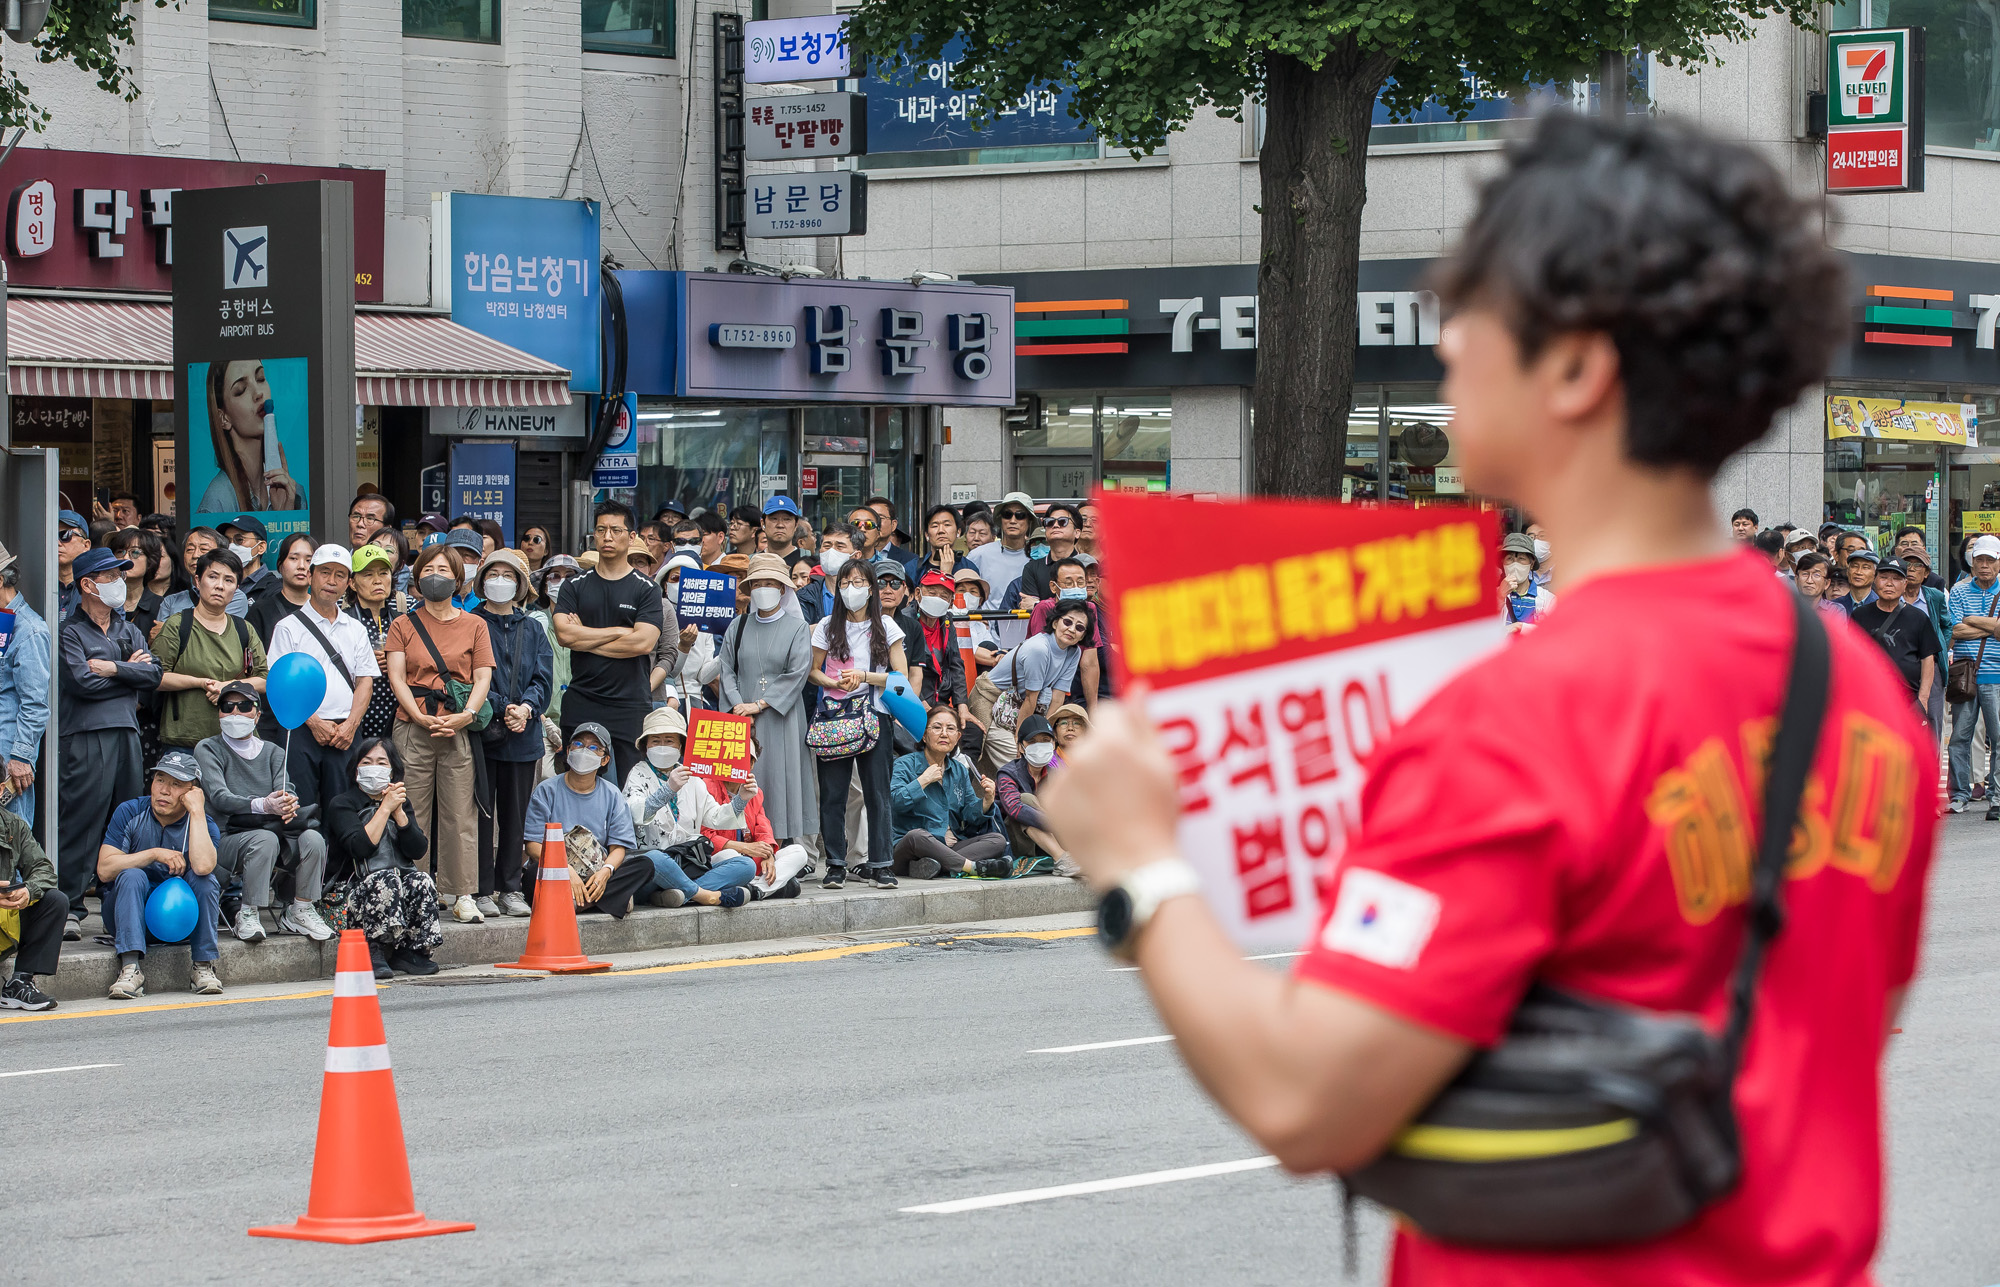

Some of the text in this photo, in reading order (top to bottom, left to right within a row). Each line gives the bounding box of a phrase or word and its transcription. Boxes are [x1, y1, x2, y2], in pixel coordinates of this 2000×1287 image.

[778, 31, 844, 65] 보청기
[751, 105, 775, 126] 북촌
[780, 103, 826, 118] T.755-1452
[775, 118, 844, 149] 단팥빵
[1832, 149, 1899, 169] 24시간편의점
[754, 183, 843, 215] 남문당
[28, 191, 44, 245] 명인
[771, 218, 822, 230] T.752-8960
[464, 251, 588, 298] 한음보청기
[218, 297, 274, 320] 공항버스
[486, 301, 567, 320] 박진희 난청센터
[219, 323, 274, 338] AIRPORT BUS
[723, 328, 793, 343] T.752-8960
[804, 304, 999, 381] 남문당
[40, 408, 90, 429] 단팥빵
[485, 415, 556, 431] HANEUM
[457, 474, 510, 486] 프리미엄 개인맞춤
[1438, 476, 1449, 484] 주차
[463, 490, 504, 506] 비스포크
[1122, 486, 1146, 494] 주차 금지
[1979, 522, 1992, 532] 30
[429, 533, 439, 544] N
[682, 577, 708, 591] 채해병
[708, 579, 725, 591] 특검
[681, 591, 706, 604] 재의결
[680, 605, 734, 619] 국민의 명령이다
[694, 719, 747, 741] 대통령의
[692, 739, 746, 760] 특검 거부
[690, 762, 748, 780] 국민이 거부한다!
